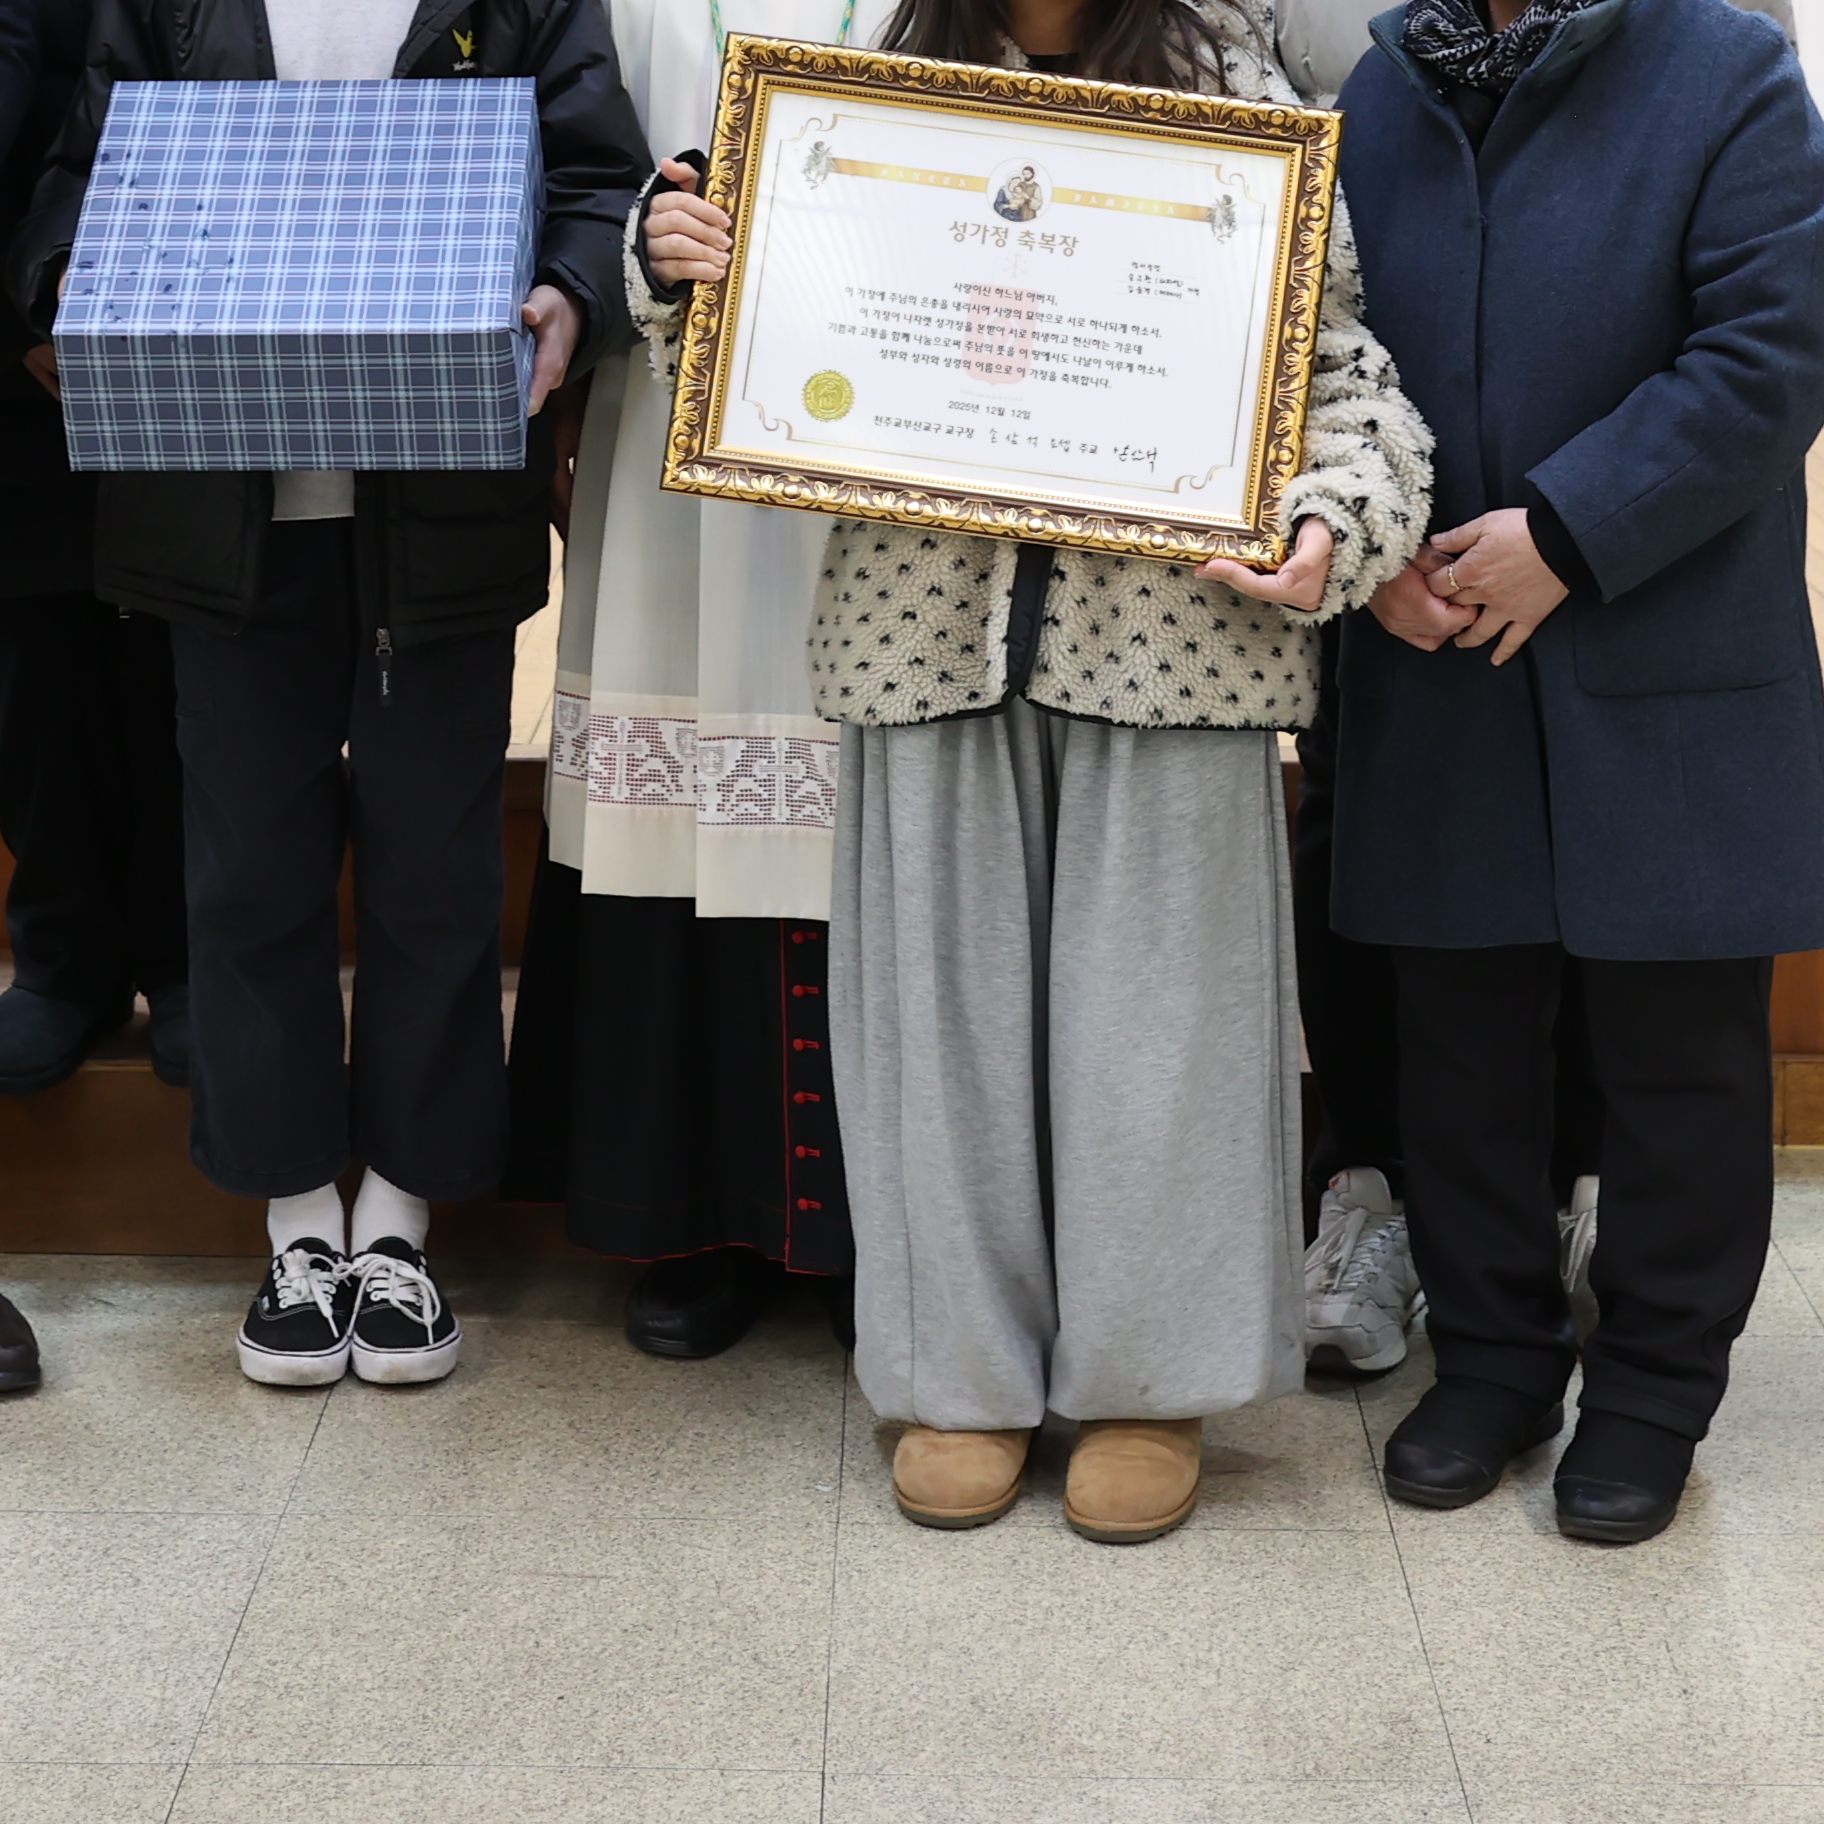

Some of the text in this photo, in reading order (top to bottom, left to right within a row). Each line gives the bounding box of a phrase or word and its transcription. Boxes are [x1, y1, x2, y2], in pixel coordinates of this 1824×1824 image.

[948, 220, 1080, 258] 성가정 축복장
[947, 400, 1031, 421] 2025년 12월 12일
[873, 415, 942, 434] 천주교부산교구
[944, 424, 975, 439] 교구장
[1079, 443, 1098, 455] 주교
